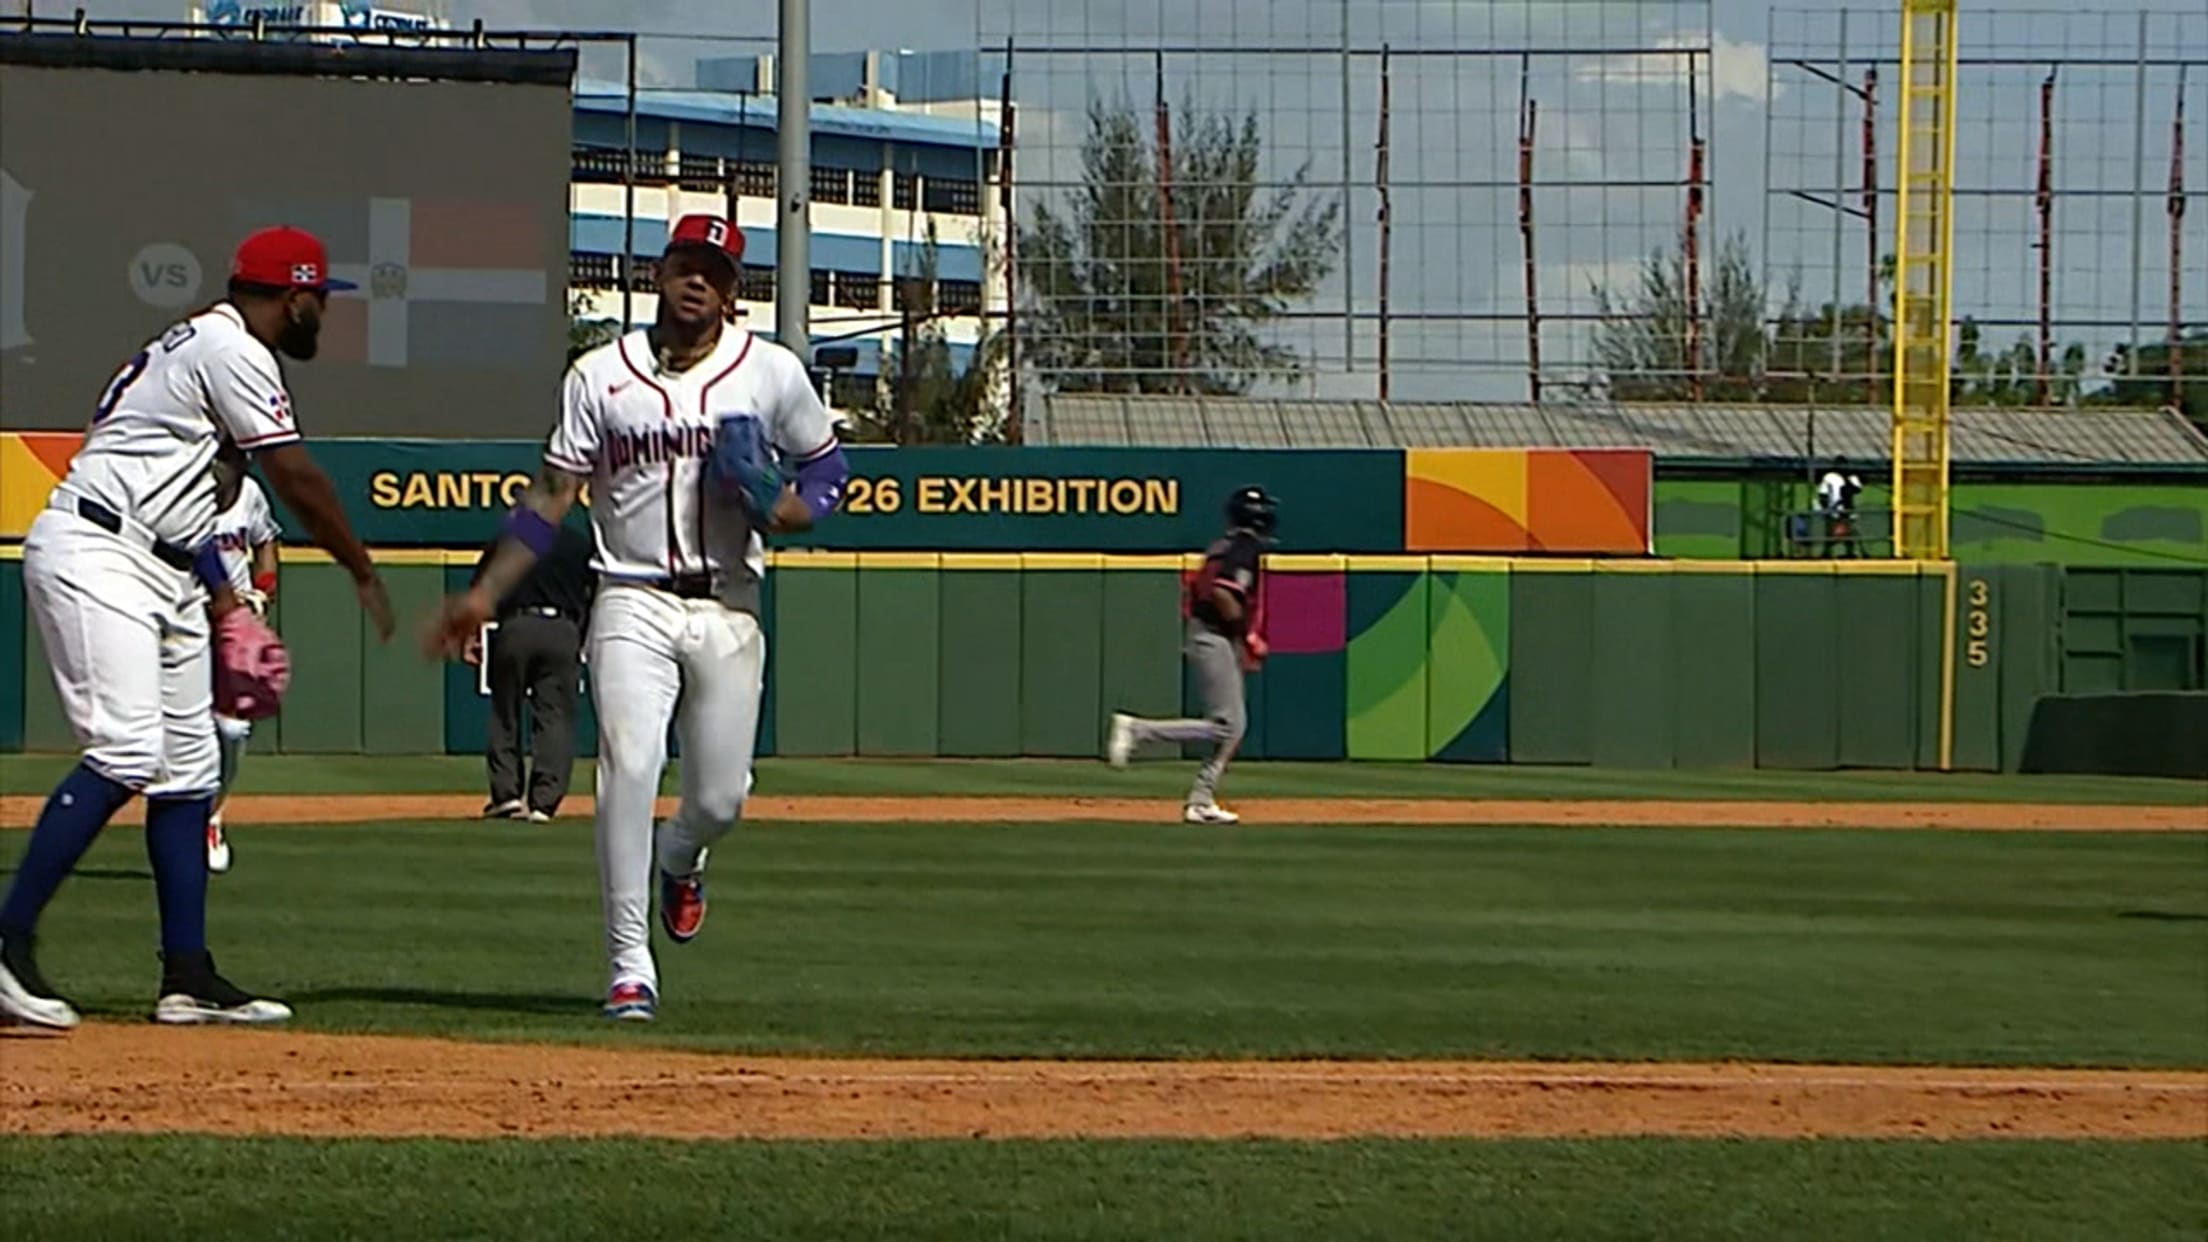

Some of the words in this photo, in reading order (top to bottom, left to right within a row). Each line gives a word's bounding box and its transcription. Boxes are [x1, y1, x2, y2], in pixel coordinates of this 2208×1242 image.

[141, 264, 188, 288] VS
[606, 422, 714, 474] DOMINIC
[843, 478, 901, 513] 26
[918, 478, 1178, 513] EXHIBITION
[1968, 580, 1988, 666] 335
